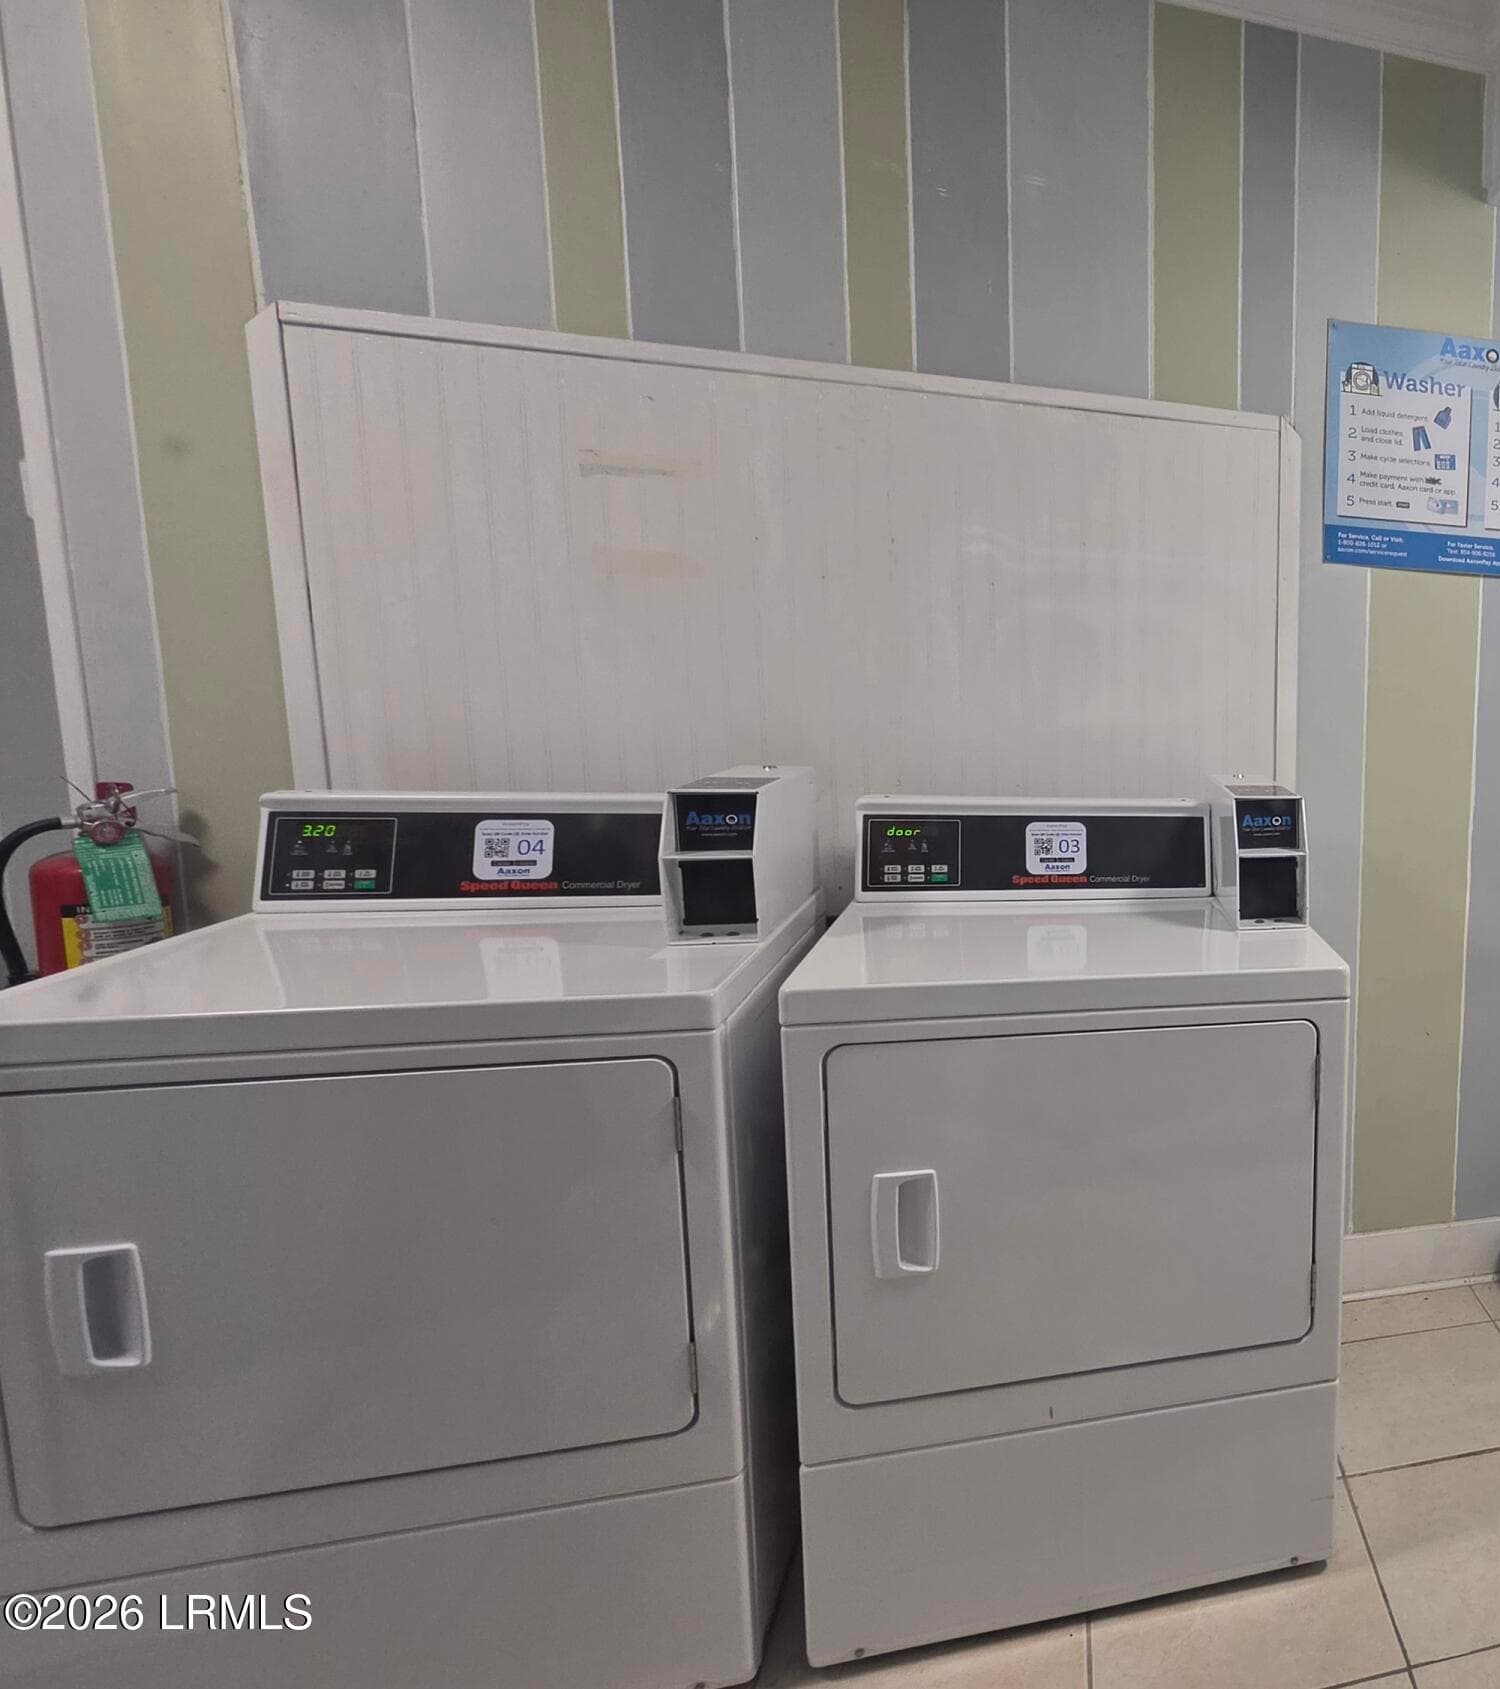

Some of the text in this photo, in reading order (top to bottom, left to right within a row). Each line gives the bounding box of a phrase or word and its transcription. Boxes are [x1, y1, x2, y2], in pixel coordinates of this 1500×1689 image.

[1384, 371, 1466, 398] Washer
[1350, 405, 1356, 416] 1
[1362, 408, 1375, 416] Add
[1377, 410, 1394, 418] liquid
[1348, 426, 1403, 438] 2 Load clothes
[1495, 422, 1500, 432] 1
[1493, 438, 1500, 450] 2
[1348, 450, 1356, 461] 3
[1360, 453, 1378, 461] Make
[1380, 455, 1397, 463] cycle
[1492, 456, 1500, 467] 3
[1347, 473, 1355, 484] 4
[1360, 471, 1377, 479] Make
[1379, 473, 1408, 482] payment
[1492, 478, 1499, 488] 4
[1397, 484, 1418, 492] Aaxon
[1346, 495, 1354, 506] 5
[1359, 498, 1377, 506] Press
[1491, 500, 1498, 511] 5
[1466, 558, 1491, 566] AaxonPay
[686, 811, 752, 825] Aaxon
[1242, 814, 1292, 826] Aaxon
[887, 826, 920, 836] door
[518, 840, 546, 855] 04
[1058, 839, 1080, 853] 03
[460, 880, 642, 892] Speed Queen Commercial Dryer
[1012, 875, 1150, 886] Speed Queen Commercial Dryer
